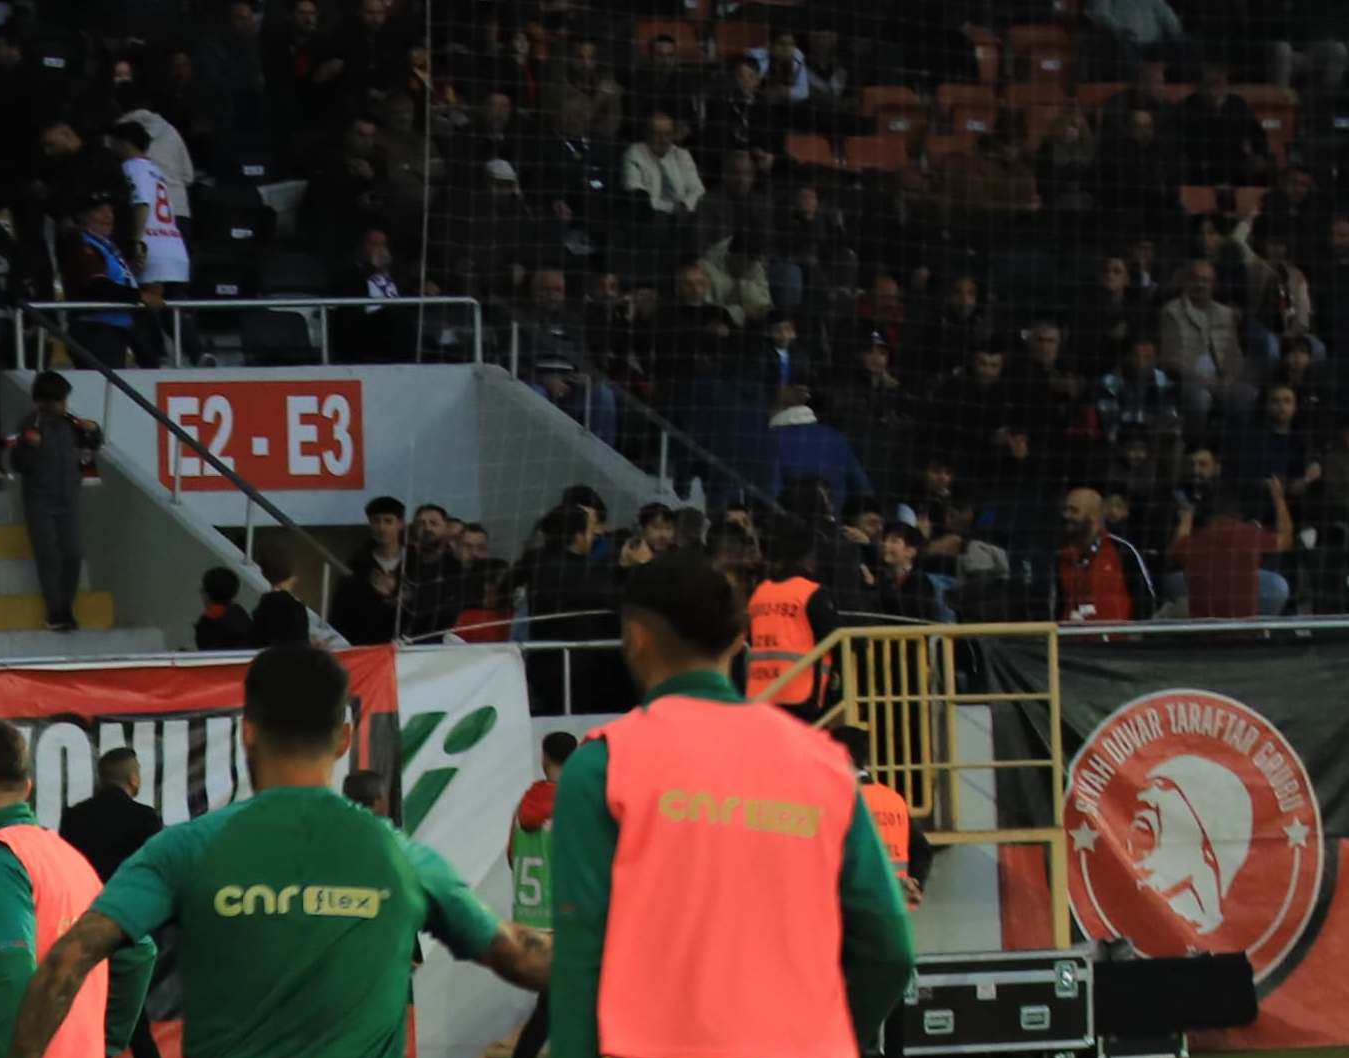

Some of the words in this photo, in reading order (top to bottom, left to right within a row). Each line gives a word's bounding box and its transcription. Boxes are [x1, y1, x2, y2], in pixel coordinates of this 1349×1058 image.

[166, 394, 235, 477] E2
[286, 393, 353, 477] E3
[1102, 706, 1164, 765] DUVAR
[1166, 702, 1260, 752] TARAFTAR
[213, 884, 301, 917] cnr
[309, 887, 375, 915] flex
